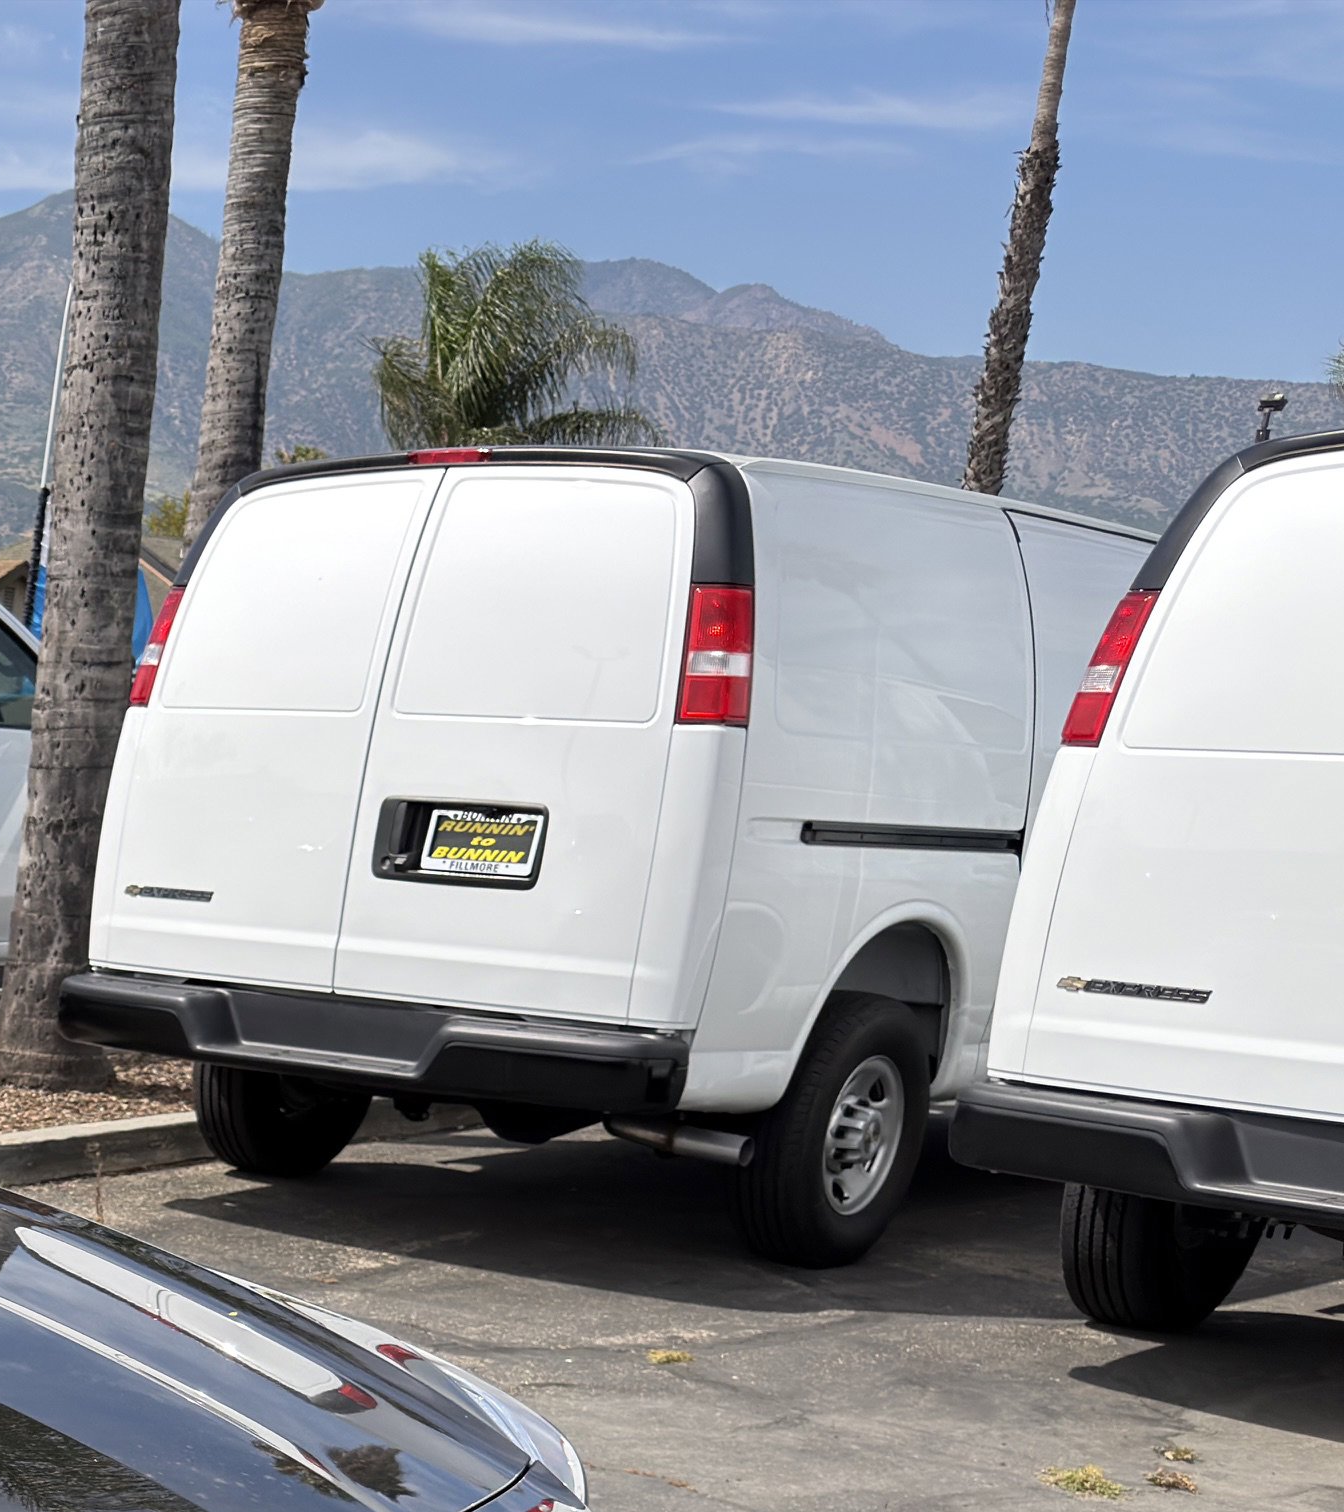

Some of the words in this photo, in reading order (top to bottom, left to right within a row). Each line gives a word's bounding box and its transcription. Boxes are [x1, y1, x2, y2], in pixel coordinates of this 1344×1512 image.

[438, 820, 535, 836] RUNNIN'
[470, 836, 496, 847] to
[431, 846, 525, 864] BUNNIN
[449, 859, 501, 874] FILLMORE
[139, 886, 214, 902] EXPRESS
[1084, 978, 1213, 1004] EXPRESS
